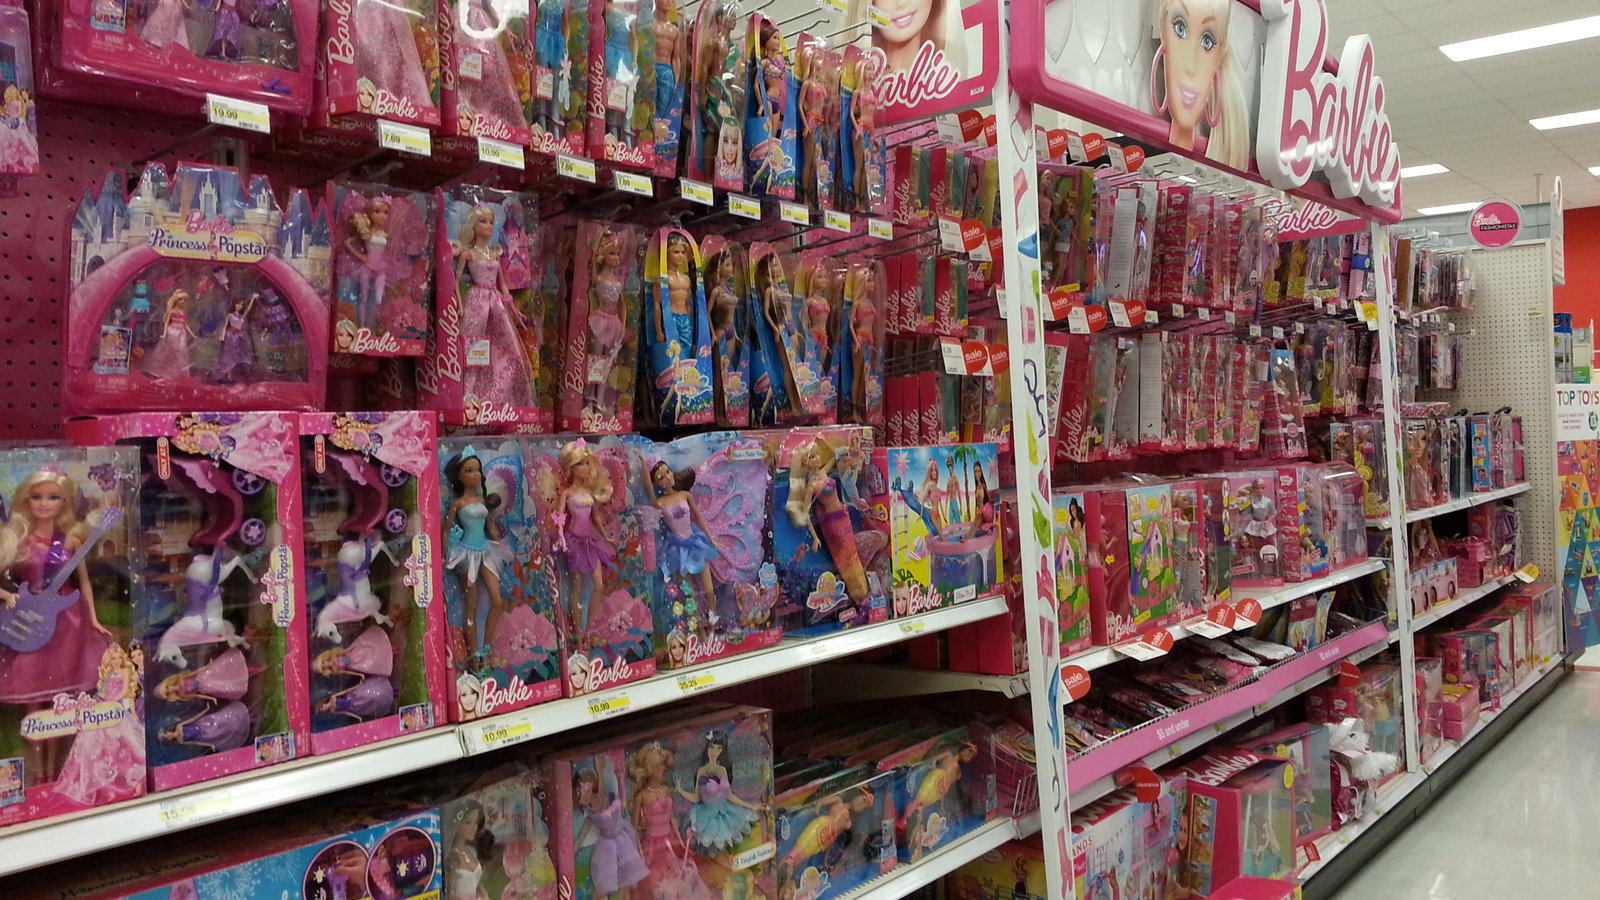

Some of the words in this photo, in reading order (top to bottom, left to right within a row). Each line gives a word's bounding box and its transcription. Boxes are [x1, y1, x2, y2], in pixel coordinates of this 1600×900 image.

[589, 54, 605, 119] Barbie
[375, 89, 418, 119] Barbie
[1264, 0, 1402, 198] Barbie
[212, 107, 239, 120] 19.99
[962, 115, 979, 129] sale
[473, 114, 512, 140] Barbie
[384, 134, 401, 143] 7.69
[542, 133, 574, 154] Barbie
[1049, 134, 1066, 146] sale
[1085, 138, 1101, 150] sale
[481, 147, 501, 158] 10.99
[616, 141, 645, 164] Barbie
[1125, 150, 1141, 162] sale
[186, 209, 236, 233] Barbie
[148, 229, 208, 251] Princess
[218, 237, 270, 256] Popstar
[963, 227, 981, 239] sale
[900, 286, 917, 332] Barbie
[934, 290, 951, 335] Barbie
[1052, 297, 1068, 308] sale
[1128, 305, 1142, 315] sale
[1088, 311, 1102, 321] sale
[354, 327, 401, 353] Barbie
[437, 295, 462, 383] Barbie
[565, 330, 586, 394] Barbie
[965, 349, 983, 361] sale
[1557, 391, 1576, 406] TOP
[1577, 391, 1600, 406] TOYS
[480, 401, 520, 424] Barbie
[593, 412, 622, 433] Barbie
[1057, 404, 1083, 462] Barbie
[909, 584, 942, 615] Barbie
[686, 633, 725, 664] Barbie
[588, 655, 633, 692] Barbie
[1064, 672, 1083, 686] sale
[53, 692, 98, 714] Barbie
[481, 675, 533, 713] Barbie
[590, 702, 610, 714] 10.99
[23, 717, 74, 736] Princess
[82, 708, 127, 726] Popstar
[484, 729, 508, 742] 10.99
